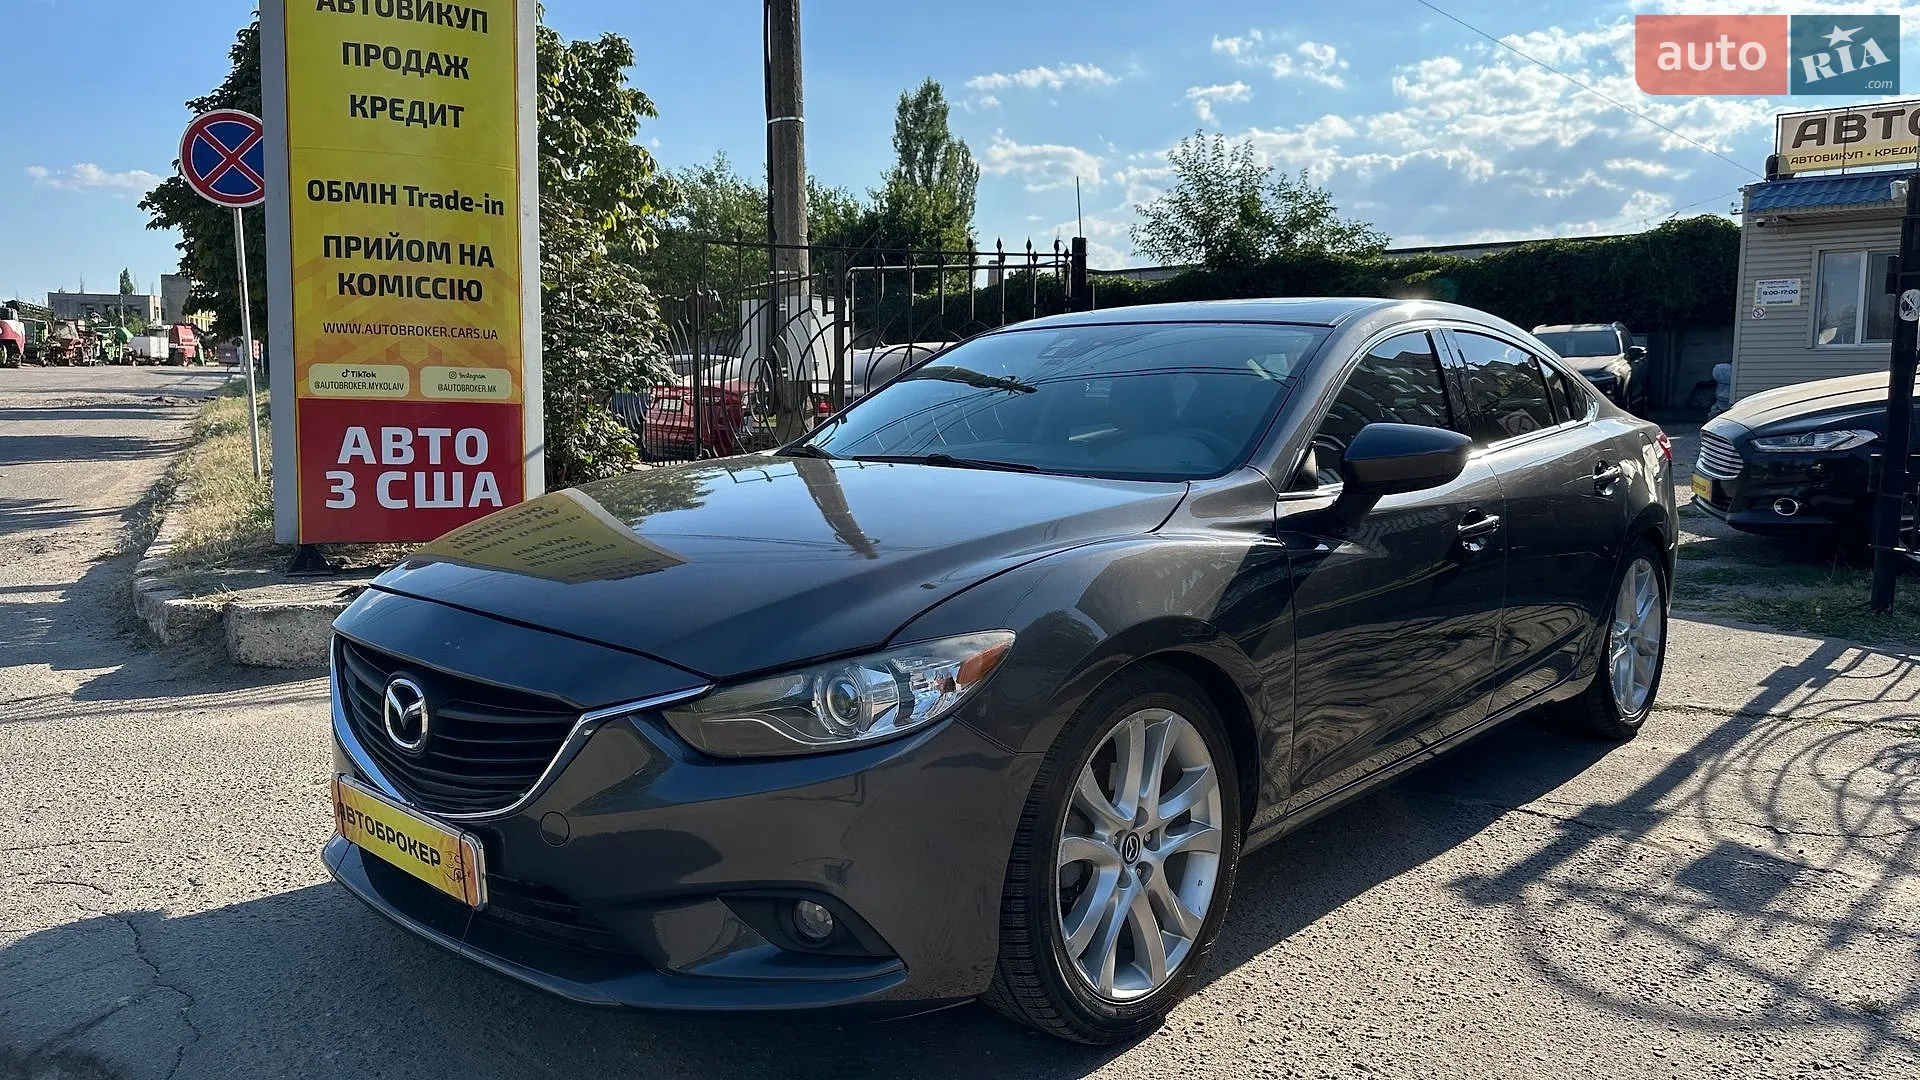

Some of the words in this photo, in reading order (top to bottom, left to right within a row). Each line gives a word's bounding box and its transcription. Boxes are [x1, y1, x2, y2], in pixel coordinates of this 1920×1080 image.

[316, 0, 489, 34] АВТОВИКУП
[342, 41, 470, 80] ПРОДАЖ
[350, 94, 465, 128] КРЕДИТ
[1790, 150, 1863, 165] АВТОВИКУП
[1874, 145, 1920, 157] КРЕДИ
[307, 179, 397, 206] ОБМІН
[403, 185, 504, 216] Trade-in
[323, 231, 451, 264] ПРИЙОМ
[459, 243, 495, 268] НА
[338, 272, 483, 302] КОМІССІЮ
[323, 322, 498, 340] WWW.AUTOBROKER.CARS.UA
[314, 380, 404, 391] @AUTOBROKER.MYKOLAIV
[350, 369, 377, 378] TikTok
[437, 383, 497, 393] @AUTOBROKER.MK
[458, 371, 487, 381] Instagram
[337, 426, 489, 466] АВТО
[376, 471, 503, 510] США
[337, 802, 441, 867] АВТОБРОКЕР
